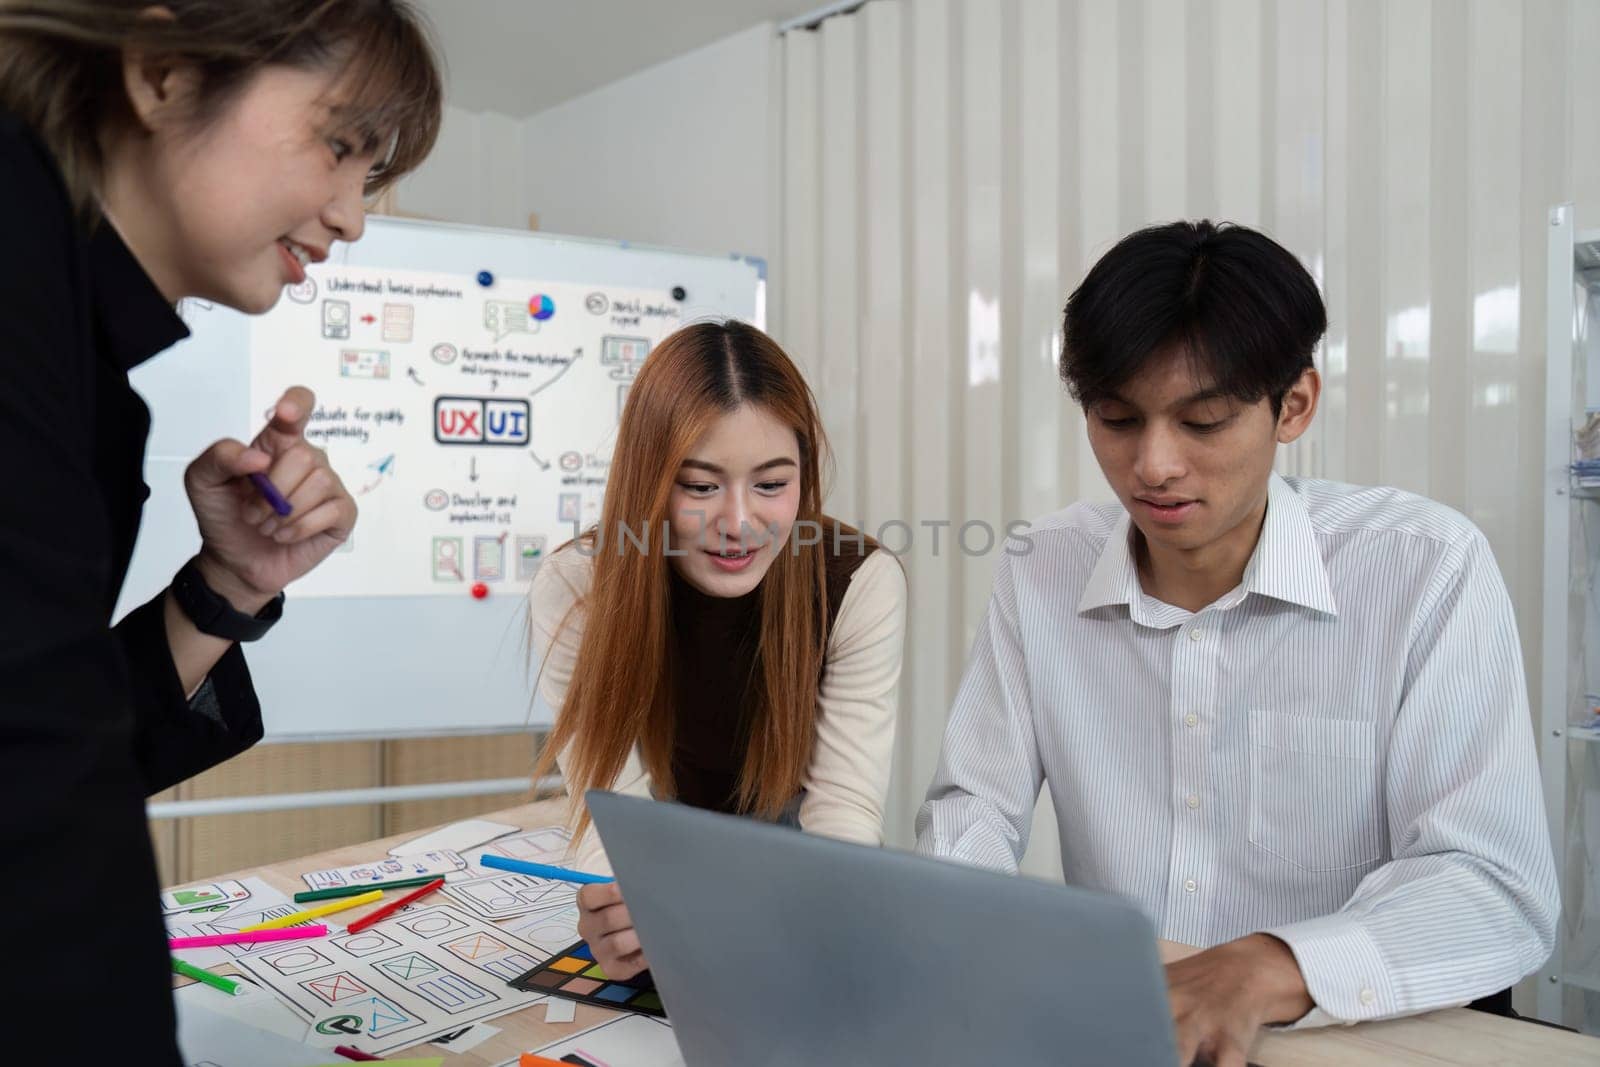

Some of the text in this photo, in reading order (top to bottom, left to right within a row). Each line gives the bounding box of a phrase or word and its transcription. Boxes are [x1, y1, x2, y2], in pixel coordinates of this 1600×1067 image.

[309, 407, 347, 421] valuate
[439, 409, 526, 437] UX UI
